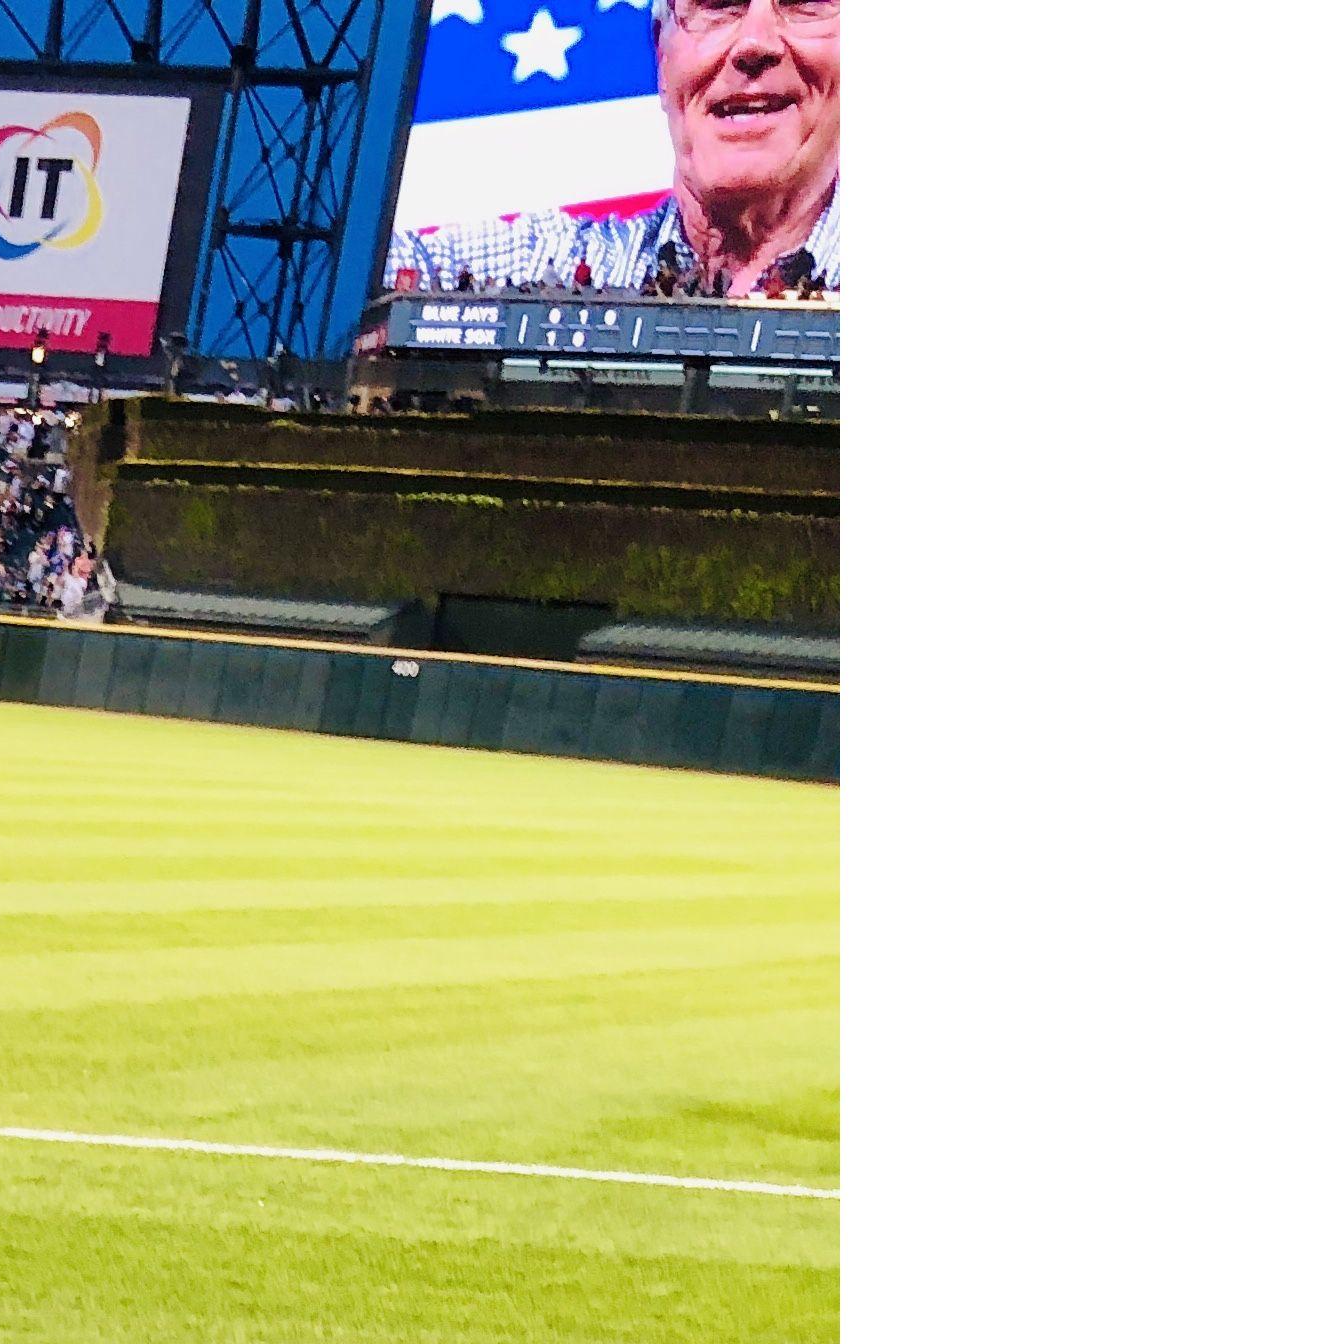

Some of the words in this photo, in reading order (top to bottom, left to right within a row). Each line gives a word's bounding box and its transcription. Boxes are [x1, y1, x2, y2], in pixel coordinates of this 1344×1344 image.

[9, 156, 74, 220] IT
[422, 305, 460, 321] BLUE
[462, 306, 499, 323] JAYS
[464, 329, 496, 345] SOX
